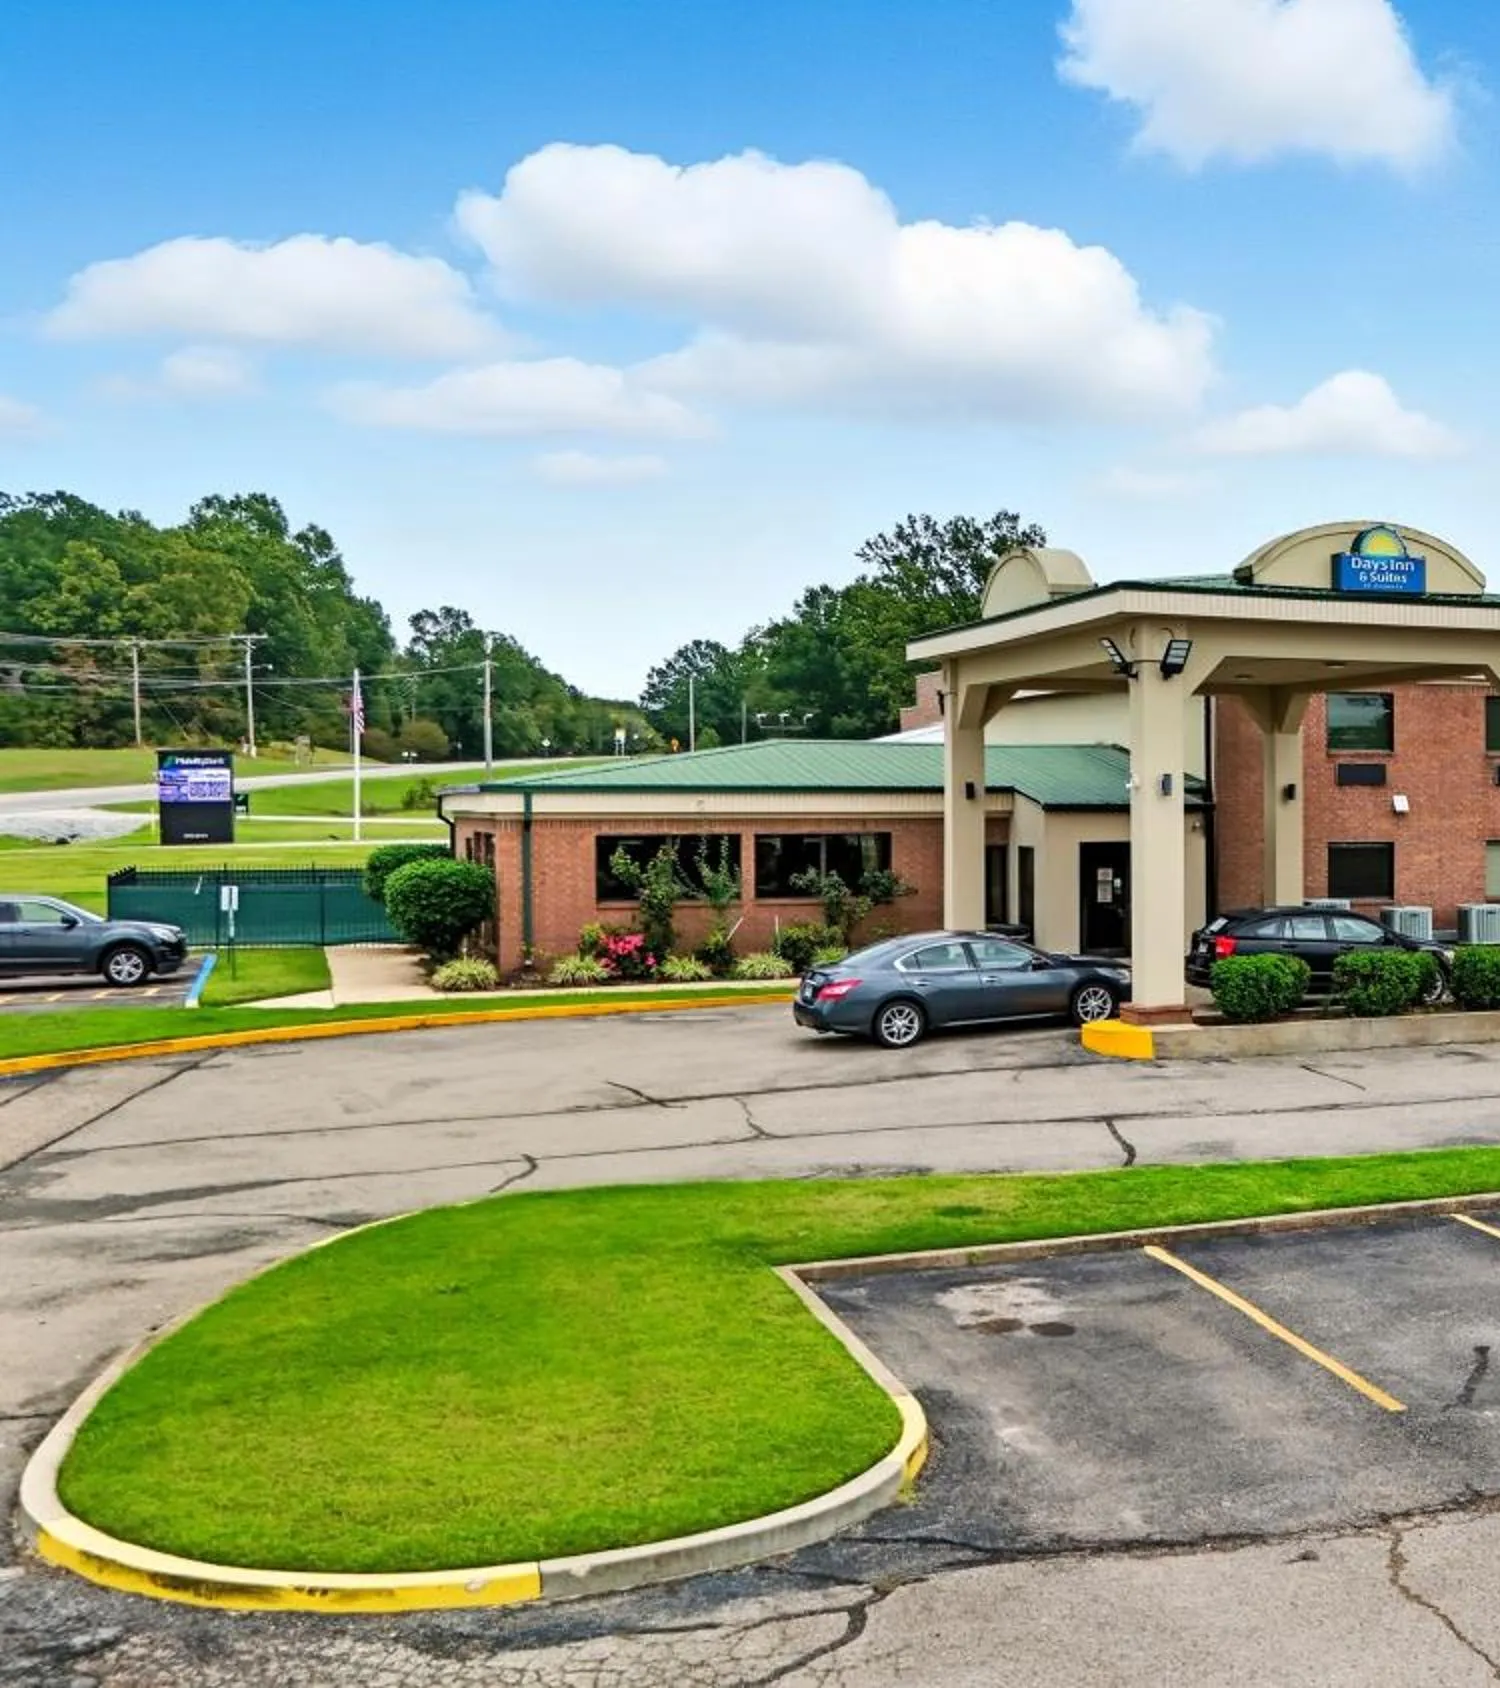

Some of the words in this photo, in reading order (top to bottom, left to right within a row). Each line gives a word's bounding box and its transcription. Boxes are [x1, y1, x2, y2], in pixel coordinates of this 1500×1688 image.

[1351, 557, 1388, 571] Days
[1390, 559, 1415, 572] Inn
[1369, 571, 1407, 583] Suites
